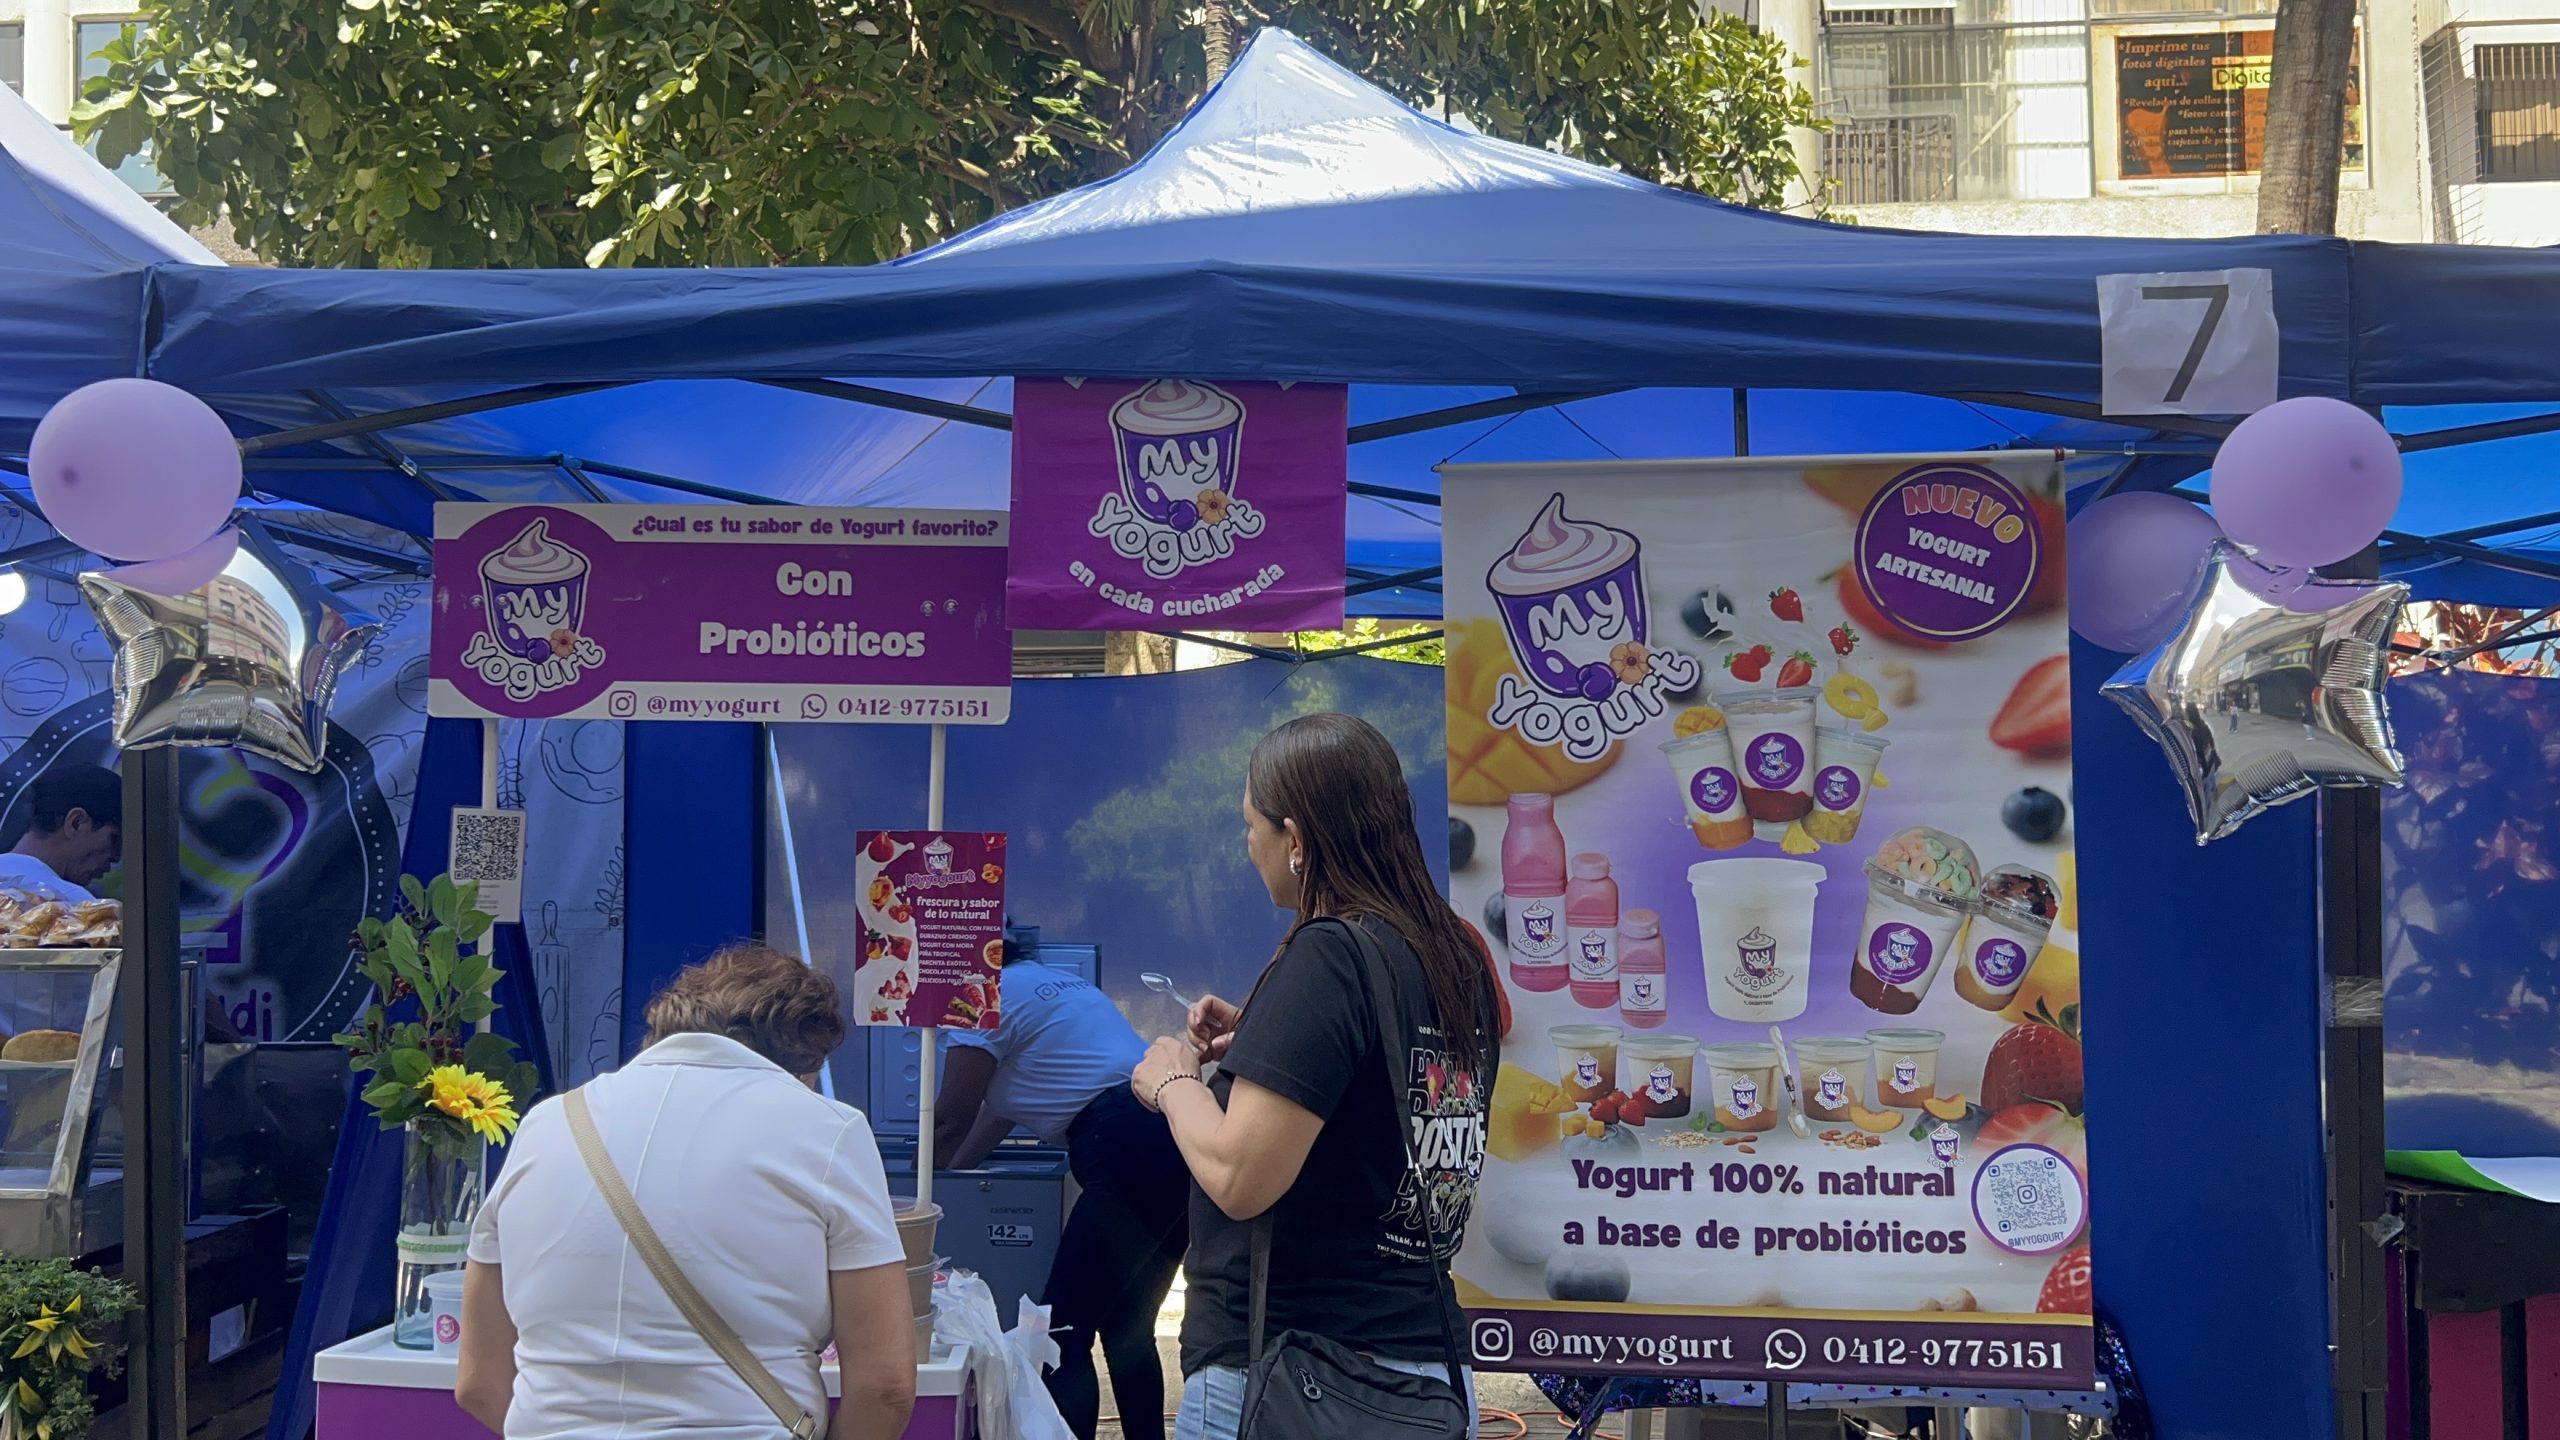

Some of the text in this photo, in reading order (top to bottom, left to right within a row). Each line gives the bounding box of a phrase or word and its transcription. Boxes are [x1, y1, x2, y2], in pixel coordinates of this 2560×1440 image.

[2121, 58, 2152, 69] fotos
[2155, 57, 2207, 70] digitales
[2191, 42, 2210, 51] tus
[2141, 284, 2228, 403] 7
[1139, 436, 1219, 483] My
[633, 516, 999, 538] ¿Cual es tu sabor de Yogurt favorito?
[1902, 484, 2024, 543] NUEVO
[1092, 496, 1262, 575] Yogurt
[1908, 527, 1990, 567] YOGURT
[776, 562, 853, 596] Con
[1069, 561, 1286, 617] en cada cucharada
[1876, 553, 1996, 604] ARTESANAL
[502, 585, 569, 625] My
[1528, 580, 1626, 649] My
[700, 621, 926, 658] Probióticos
[467, 636, 603, 697] Yogurt
[647, 695, 990, 719] @myyogurt 0412-9775151
[1493, 650, 1694, 758] Yogurt
[917, 896, 1000, 909] frescura y sabor
[925, 909, 990, 919] de lo natural
[1746, 950, 1770, 964] My
[1733, 967, 1784, 991] Yogurt
[1571, 1159, 1955, 1198] Yogurt 100% natural
[987, 1225, 1016, 1238] 142
[1563, 1216, 1967, 1255] a base de probióticos
[1529, 1328, 2064, 1369] @myyogurt 0412-9775151
